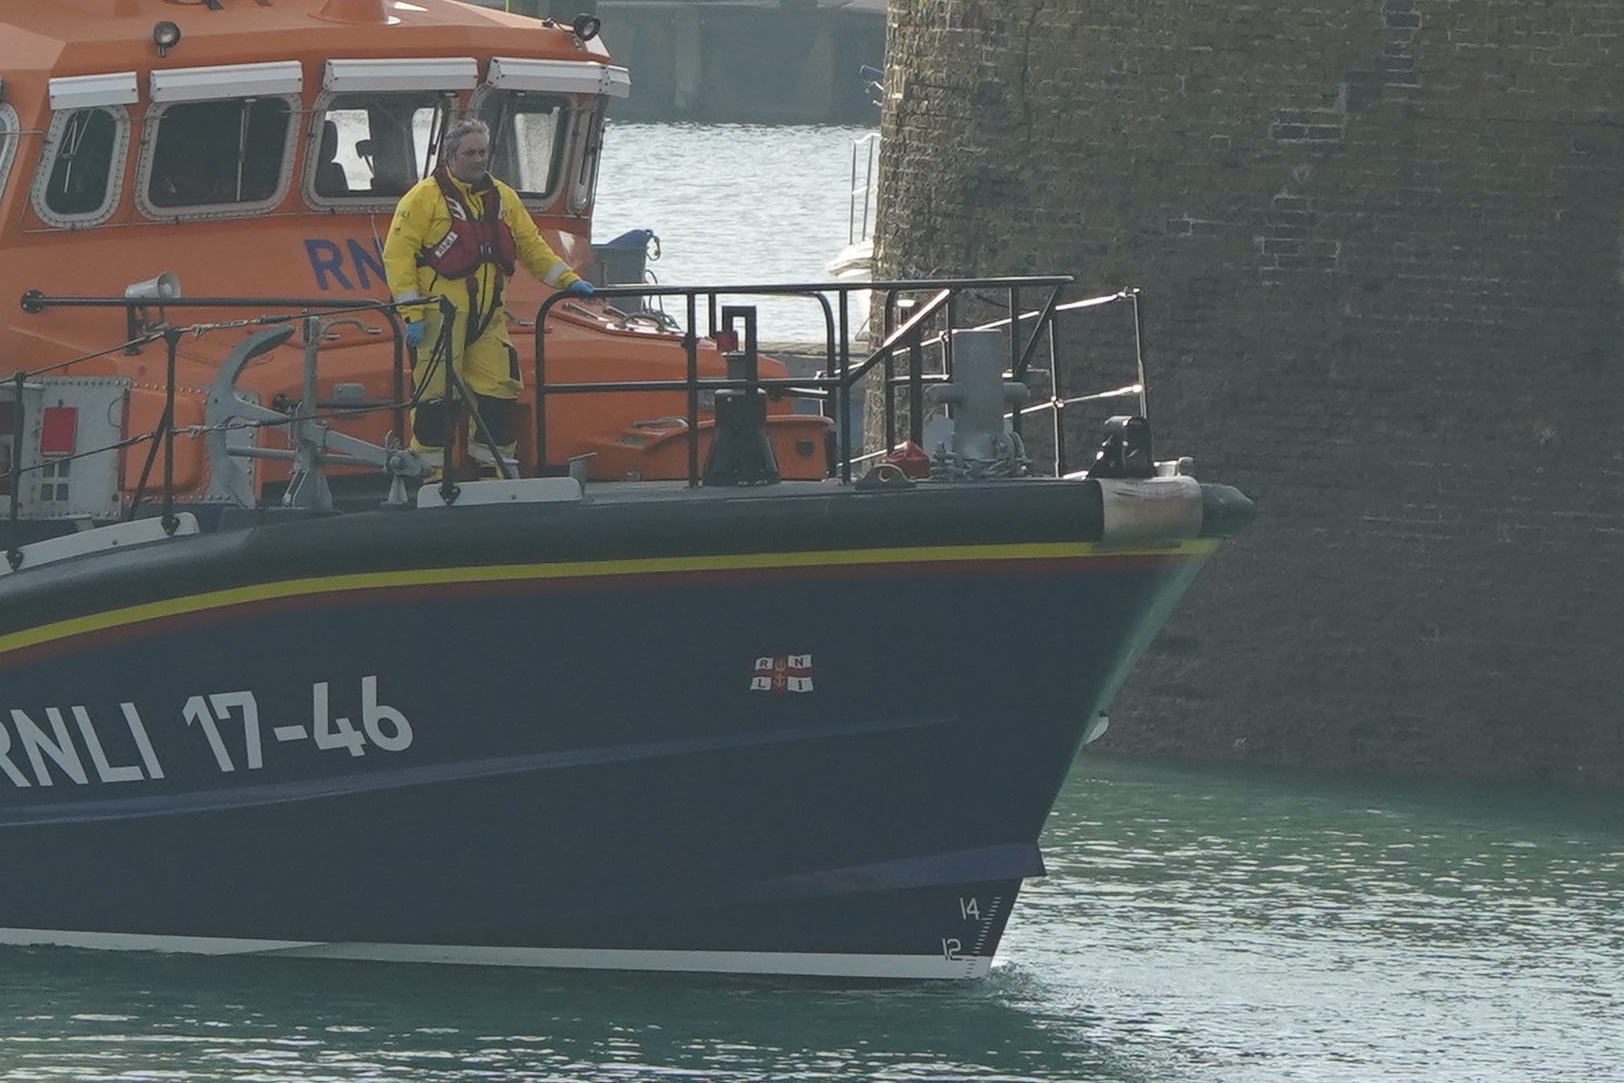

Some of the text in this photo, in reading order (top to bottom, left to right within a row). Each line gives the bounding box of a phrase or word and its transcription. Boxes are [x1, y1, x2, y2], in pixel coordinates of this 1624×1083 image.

[182, 675, 413, 772] 17-46
[960, 897, 980, 920] 14
[942, 938, 963, 961] 12
